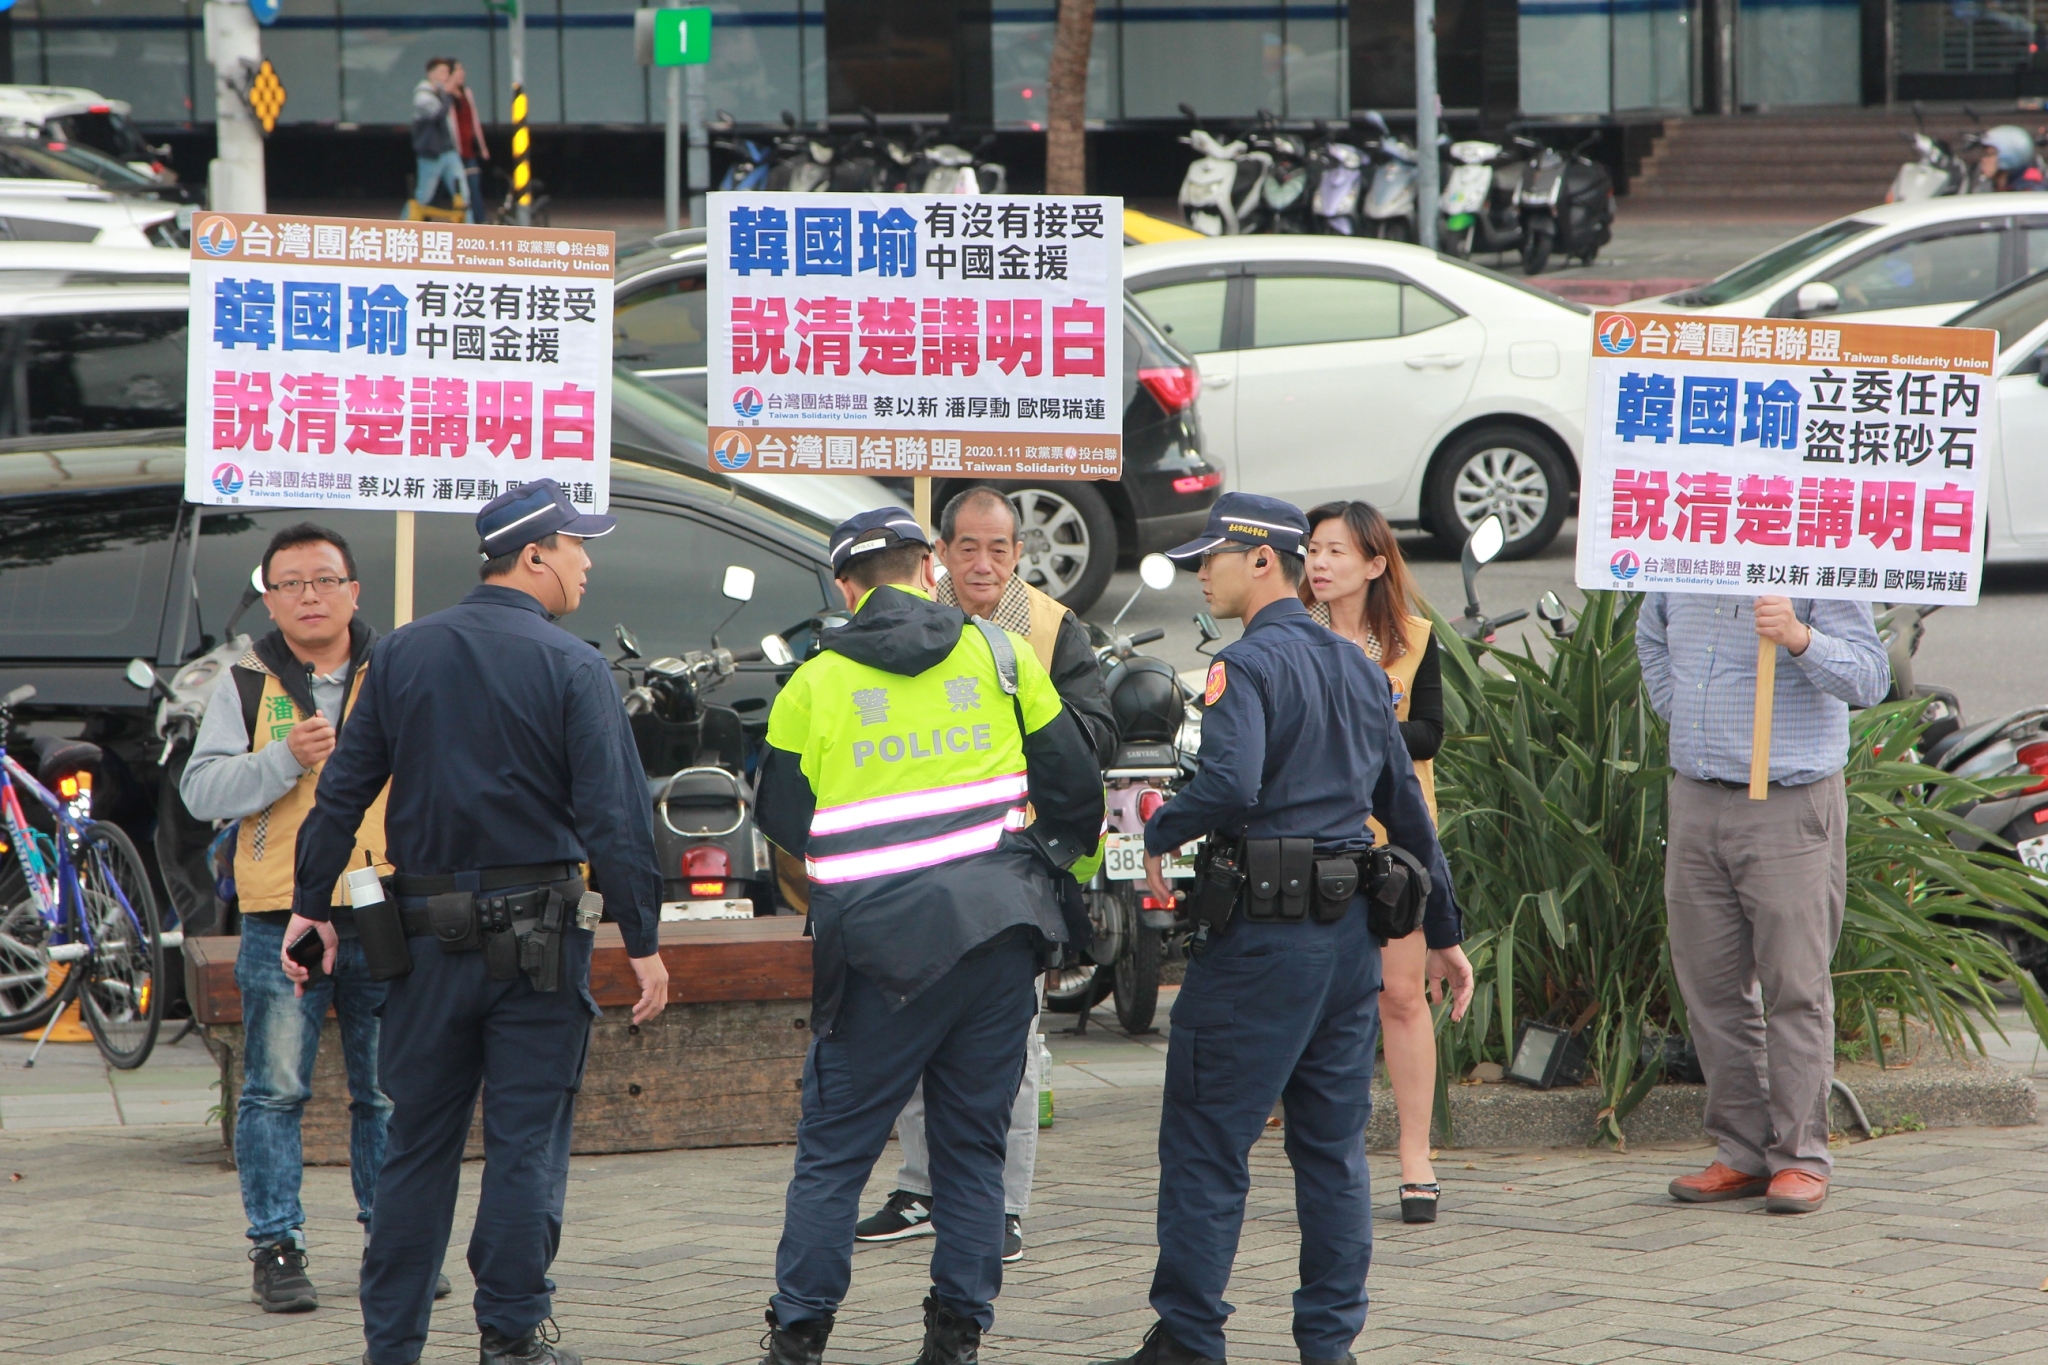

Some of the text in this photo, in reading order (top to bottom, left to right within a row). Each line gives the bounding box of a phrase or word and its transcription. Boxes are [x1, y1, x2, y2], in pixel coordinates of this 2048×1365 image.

[678, 19, 688, 54] 1
[925, 202, 1104, 239] 有沒有接受
[241, 221, 454, 264] 台灣團結聯盟
[456, 238, 513, 252] 2020.1.11
[728, 206, 918, 278] 韓國瑜
[456, 254, 610, 271] Taiwan Solidarity Union
[925, 243, 1068, 280] 中國金援
[213, 277, 408, 356] 韓國瑜
[416, 281, 596, 323] 有沒有接受
[416, 323, 559, 364] 中國金援
[731, 296, 1106, 378] 說清楚講明白
[1639, 319, 1841, 363] 台灣團結聯盟
[1843, 352, 1989, 369] Taiwan Solidarity Union
[767, 393, 868, 411] 台灣團結聯盟
[873, 396, 1106, 421] 蔡以新 潘厚勳 歐陽瑞蓮
[1615, 371, 1802, 450] 韓國瑜
[1807, 368, 1980, 418] 立委任內
[212, 369, 595, 461] 說清楚講明白
[768, 411, 868, 421] Taiwan Solidarity Union
[755, 434, 963, 471] 台灣團結聯盟
[965, 446, 1020, 458] 2020.1.11
[1803, 419, 1977, 470] 盜採砂石
[248, 470, 352, 490] 台灣團結聯盟
[965, 461, 1118, 475] Taiwan Solidarity Union
[249, 489, 351, 500] Taiwan Solidarity Union
[358, 475, 425, 499] 蔡以新
[432, 478, 498, 501] 潘厚勳
[1611, 468, 1975, 553] 說清楚講明白
[1644, 557, 1741, 577] 台灣團結聯盟
[1644, 575, 1740, 587] Taiwan Solidarity Union
[1746, 563, 1968, 592] 蔡以新 潘厚勳 歐陽瑞蓮
[852, 723, 991, 768] POLICE
[1126, 750, 1160, 759] SANYANG
